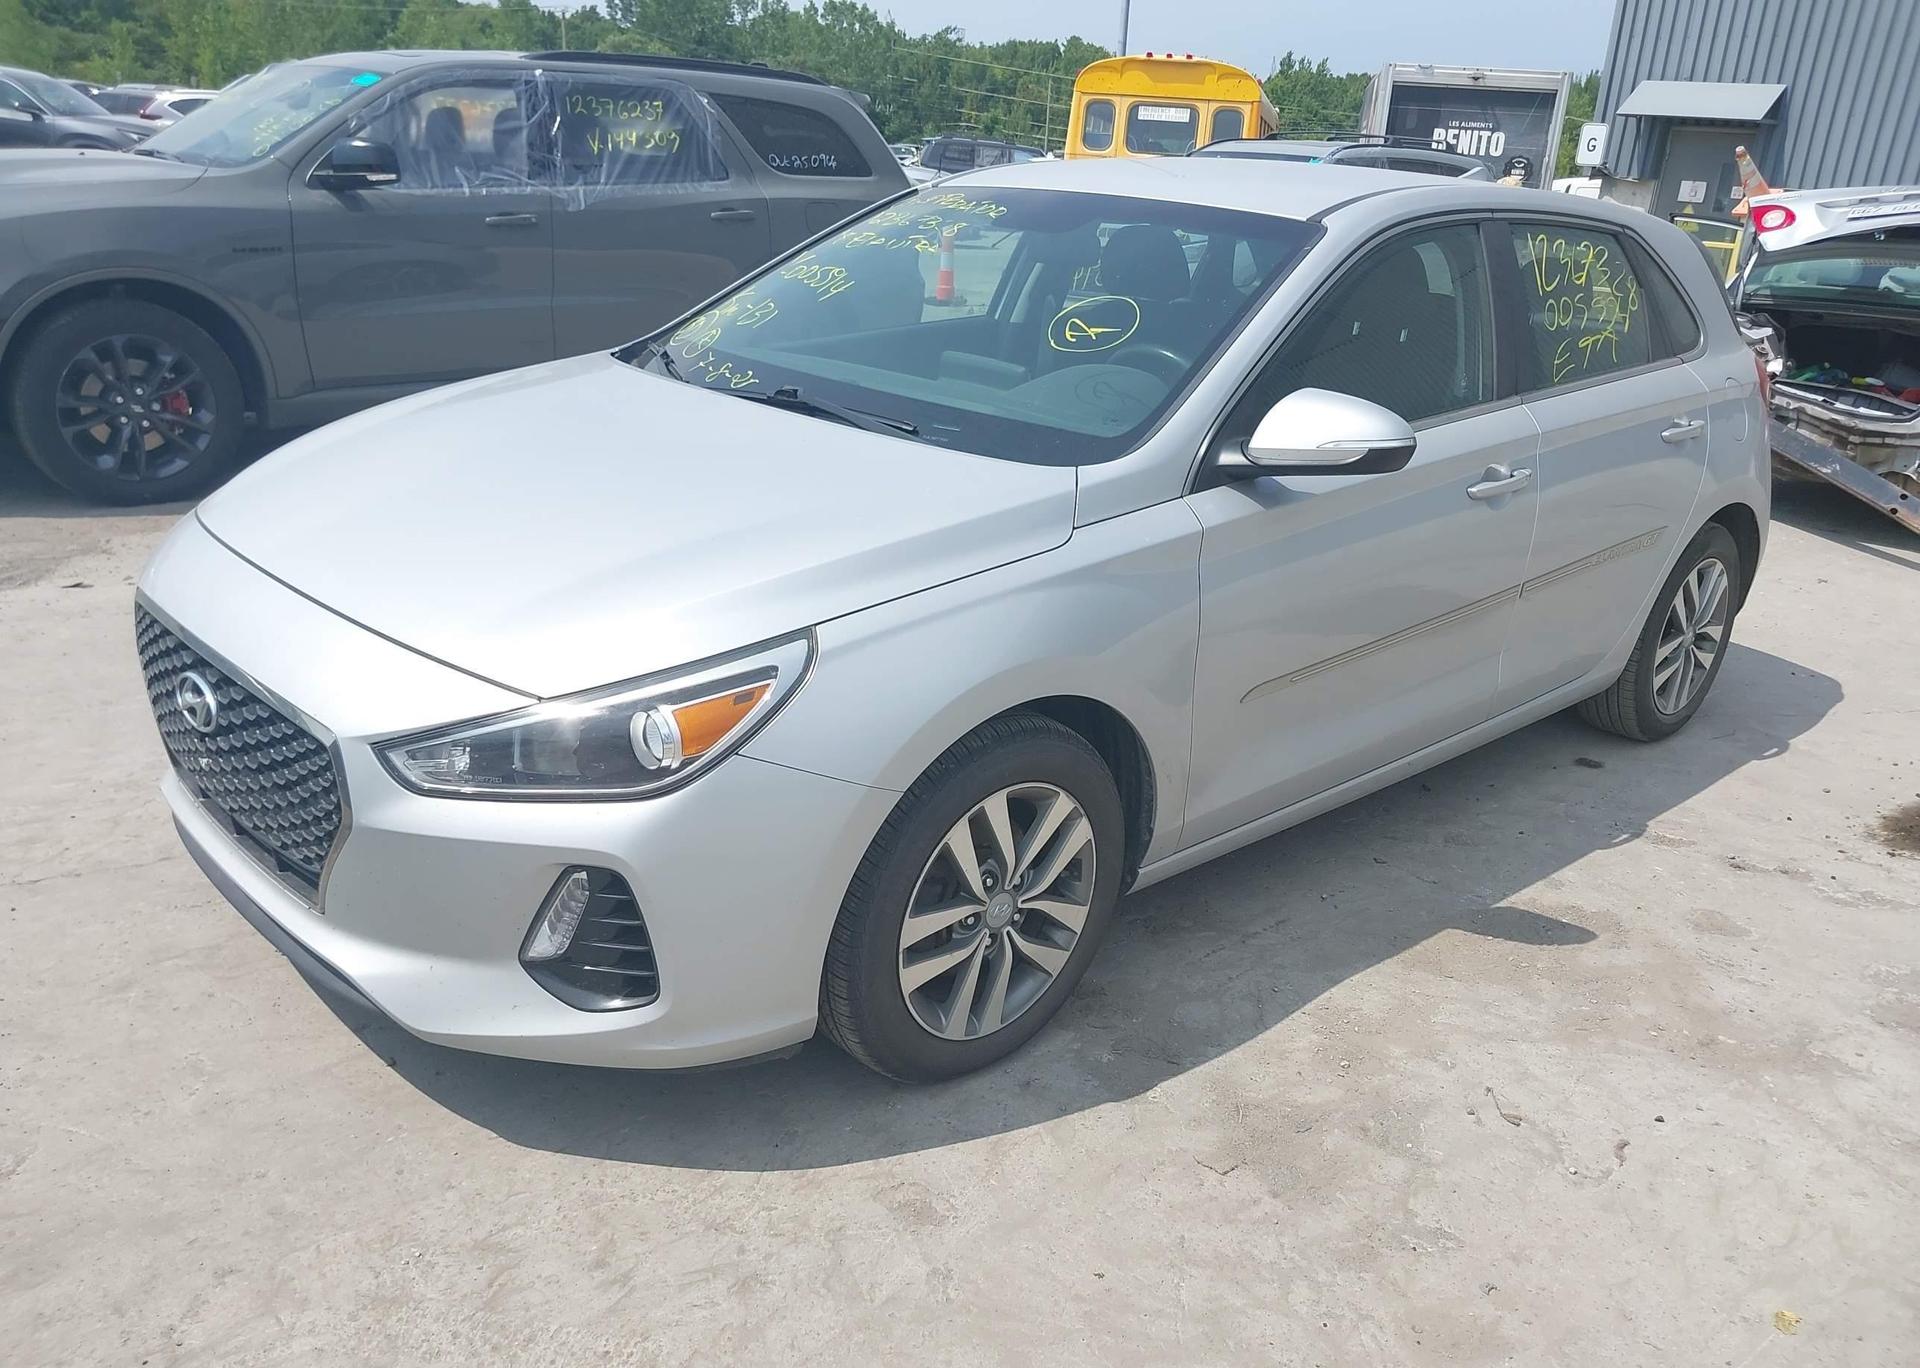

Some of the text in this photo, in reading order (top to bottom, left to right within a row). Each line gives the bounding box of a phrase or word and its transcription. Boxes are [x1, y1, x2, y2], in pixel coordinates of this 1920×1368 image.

[566, 95, 663, 120] 12376237
[1461, 121, 1493, 129] ALIMENTS
[1431, 128, 1506, 157] BENITO
[1586, 137, 1598, 153] G
[1543, 293, 1630, 334] 005594
